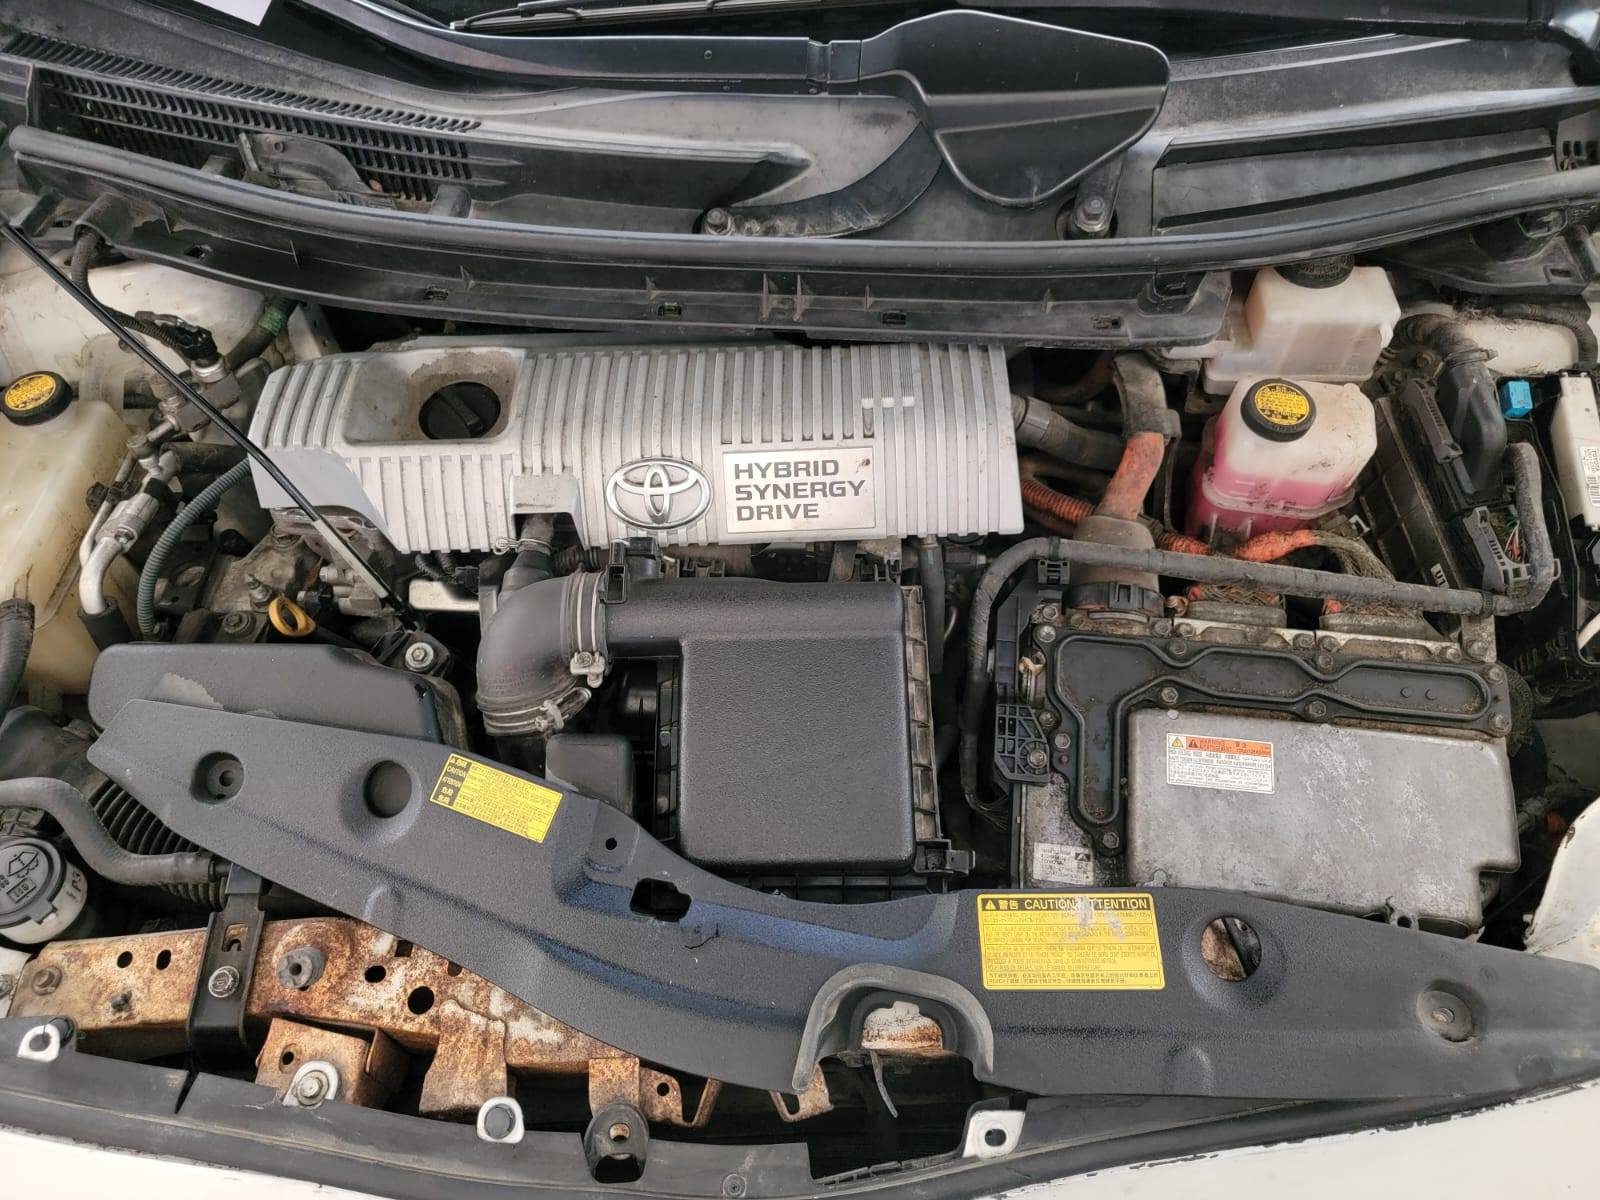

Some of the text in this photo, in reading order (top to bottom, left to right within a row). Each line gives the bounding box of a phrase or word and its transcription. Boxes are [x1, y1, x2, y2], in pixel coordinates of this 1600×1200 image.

[734, 460, 840, 480] HYBRID
[735, 480, 866, 501] SYNERGY
[736, 503, 820, 522] DRIVE
[1024, 899, 1077, 911] CAUTION
[1084, 898, 1148, 910] TTENTION
